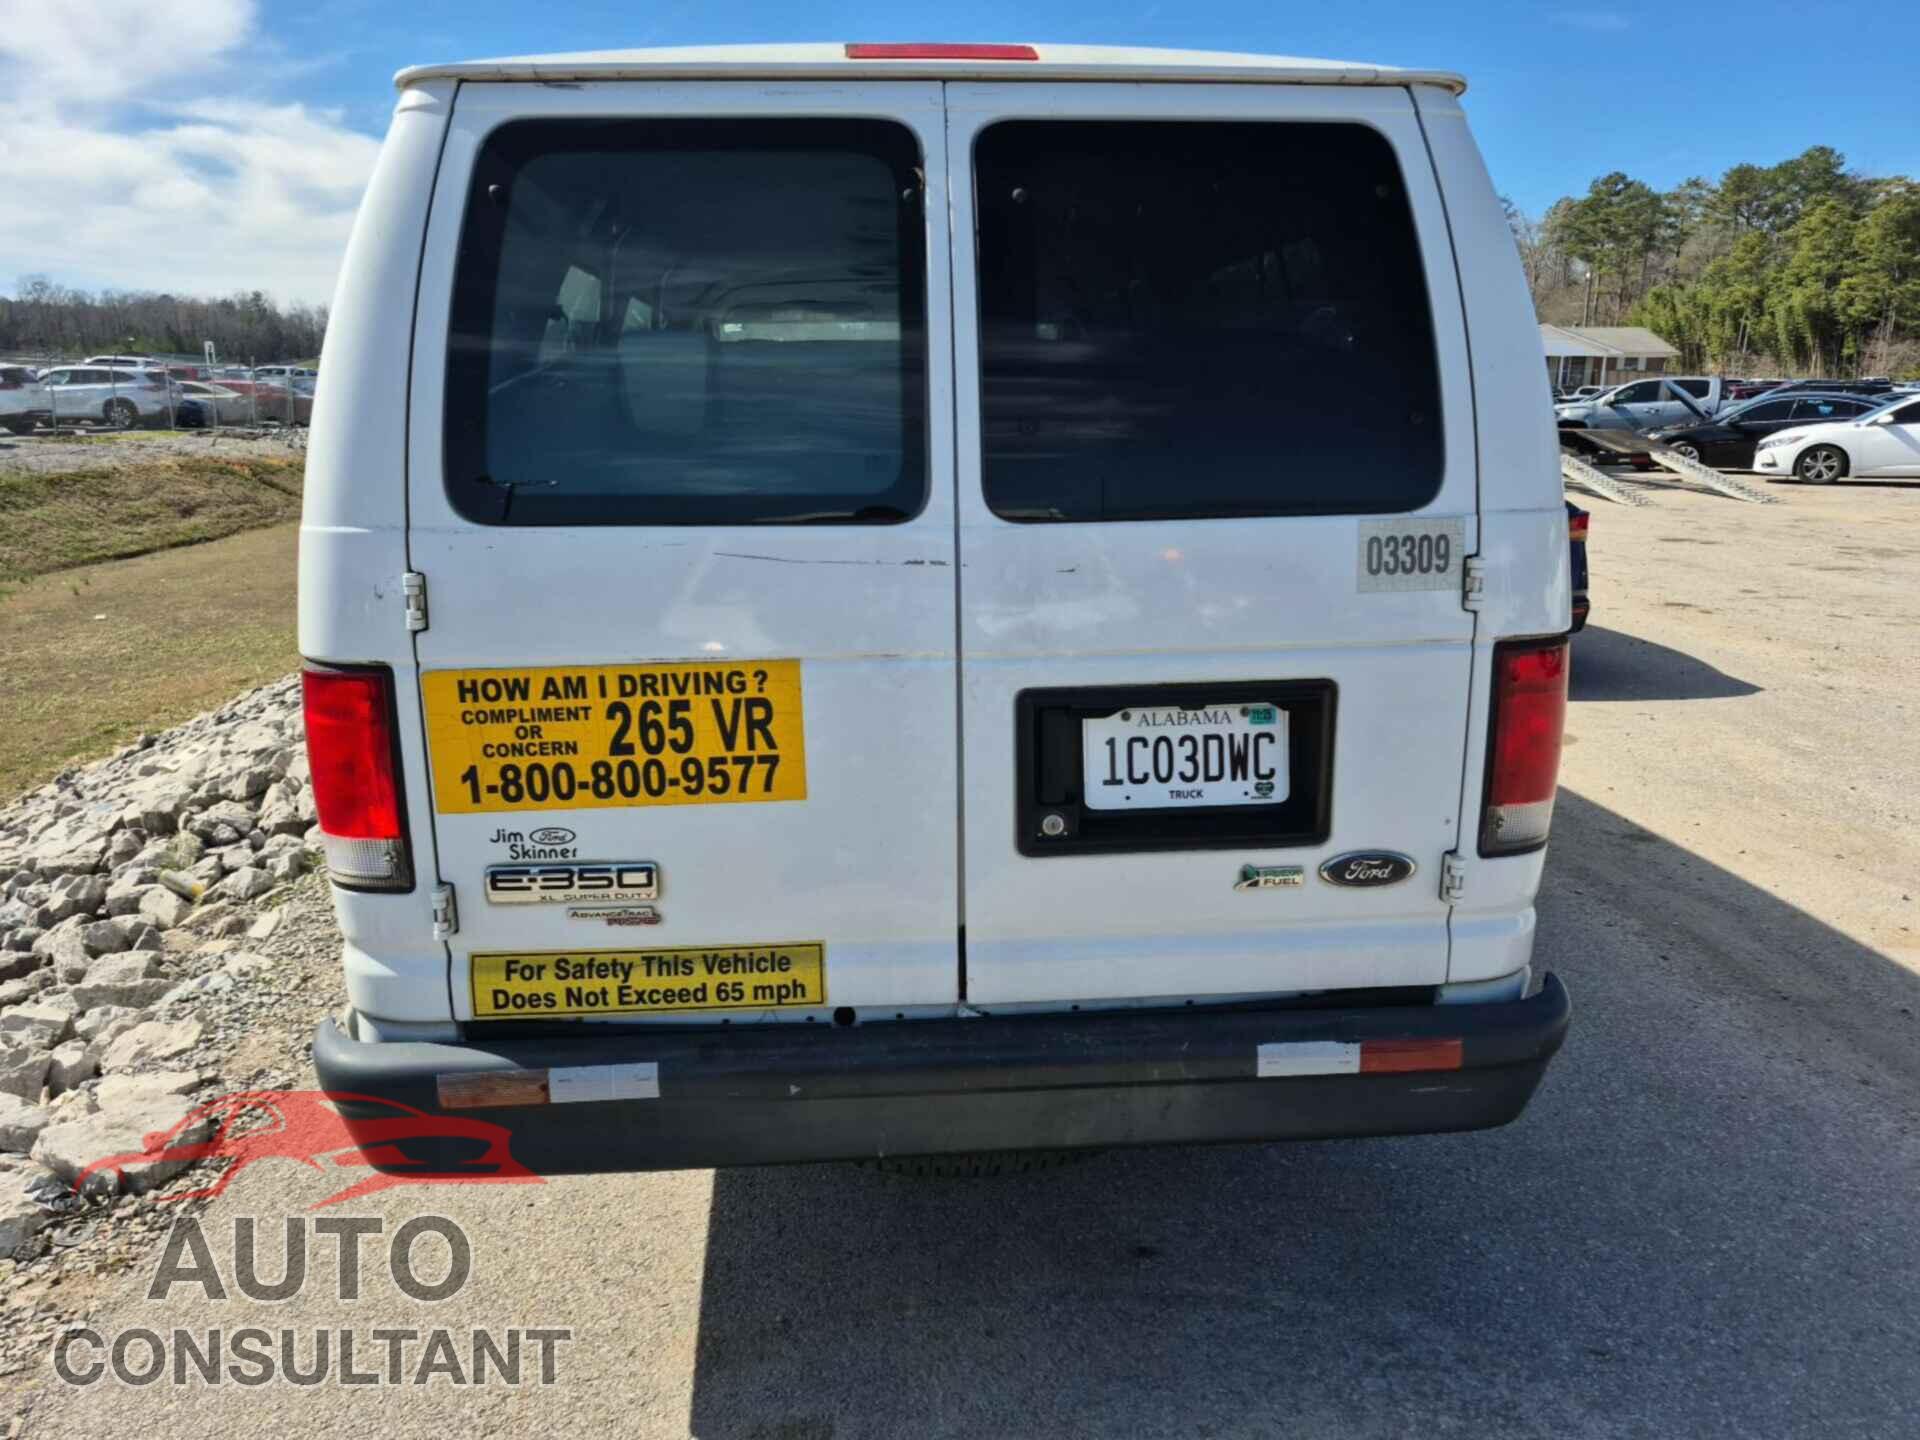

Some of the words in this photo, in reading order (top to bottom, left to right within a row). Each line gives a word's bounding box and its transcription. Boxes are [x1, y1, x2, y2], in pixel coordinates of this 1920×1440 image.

[1366, 533, 1450, 575] 03309
[457, 678, 530, 703] HOW
[540, 675, 588, 700] AM
[598, 675, 607, 699] I
[461, 706, 592, 726] COMPLIMENT
[1137, 709, 1233, 728] ALABAMA
[514, 725, 543, 741] OR
[605, 698, 695, 757] 265
[711, 696, 779, 753] VR
[482, 740, 579, 759] CONCERN
[1102, 732, 1276, 786] 1C03DWC
[459, 755, 781, 805] 1-800-800-9577
[1168, 789, 1204, 800] TRUCK
[489, 828, 524, 844] Jim
[508, 843, 578, 861] Skinner
[489, 866, 655, 892] E-350
[1344, 859, 1394, 880] Ford
[1262, 878, 1301, 888] FUEL
[562, 892, 611, 901] SUPER
[614, 891, 653, 900] DUTY
[505, 959, 546, 982] For
[554, 954, 633, 983] Safety
[641, 953, 694, 978] This
[702, 951, 792, 976] Vehicle
[491, 986, 557, 1010] Does
[565, 985, 609, 1008] Not
[617, 981, 708, 1007] Exceed
[715, 981, 745, 1002] 65
[753, 978, 806, 1005] mph
